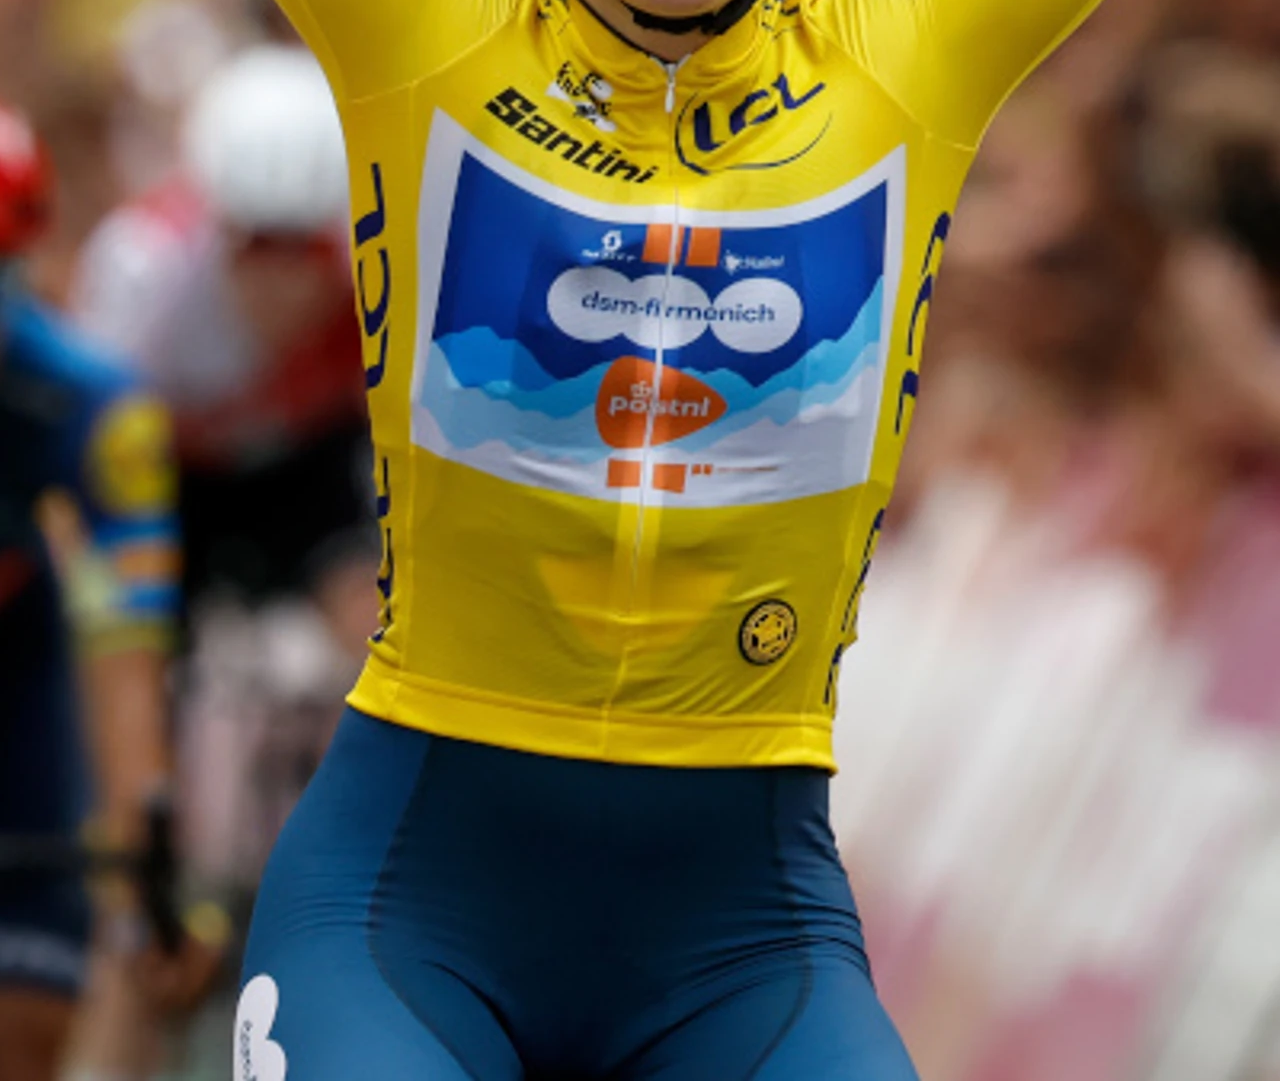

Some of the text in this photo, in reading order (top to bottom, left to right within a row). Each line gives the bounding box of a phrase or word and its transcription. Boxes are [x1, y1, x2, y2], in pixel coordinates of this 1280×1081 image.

[485, 86, 658, 183] Santini
[694, 73, 825, 152] LCL
[354, 163, 391, 391] LCL
[581, 291, 775, 322] dsm-firmenich
